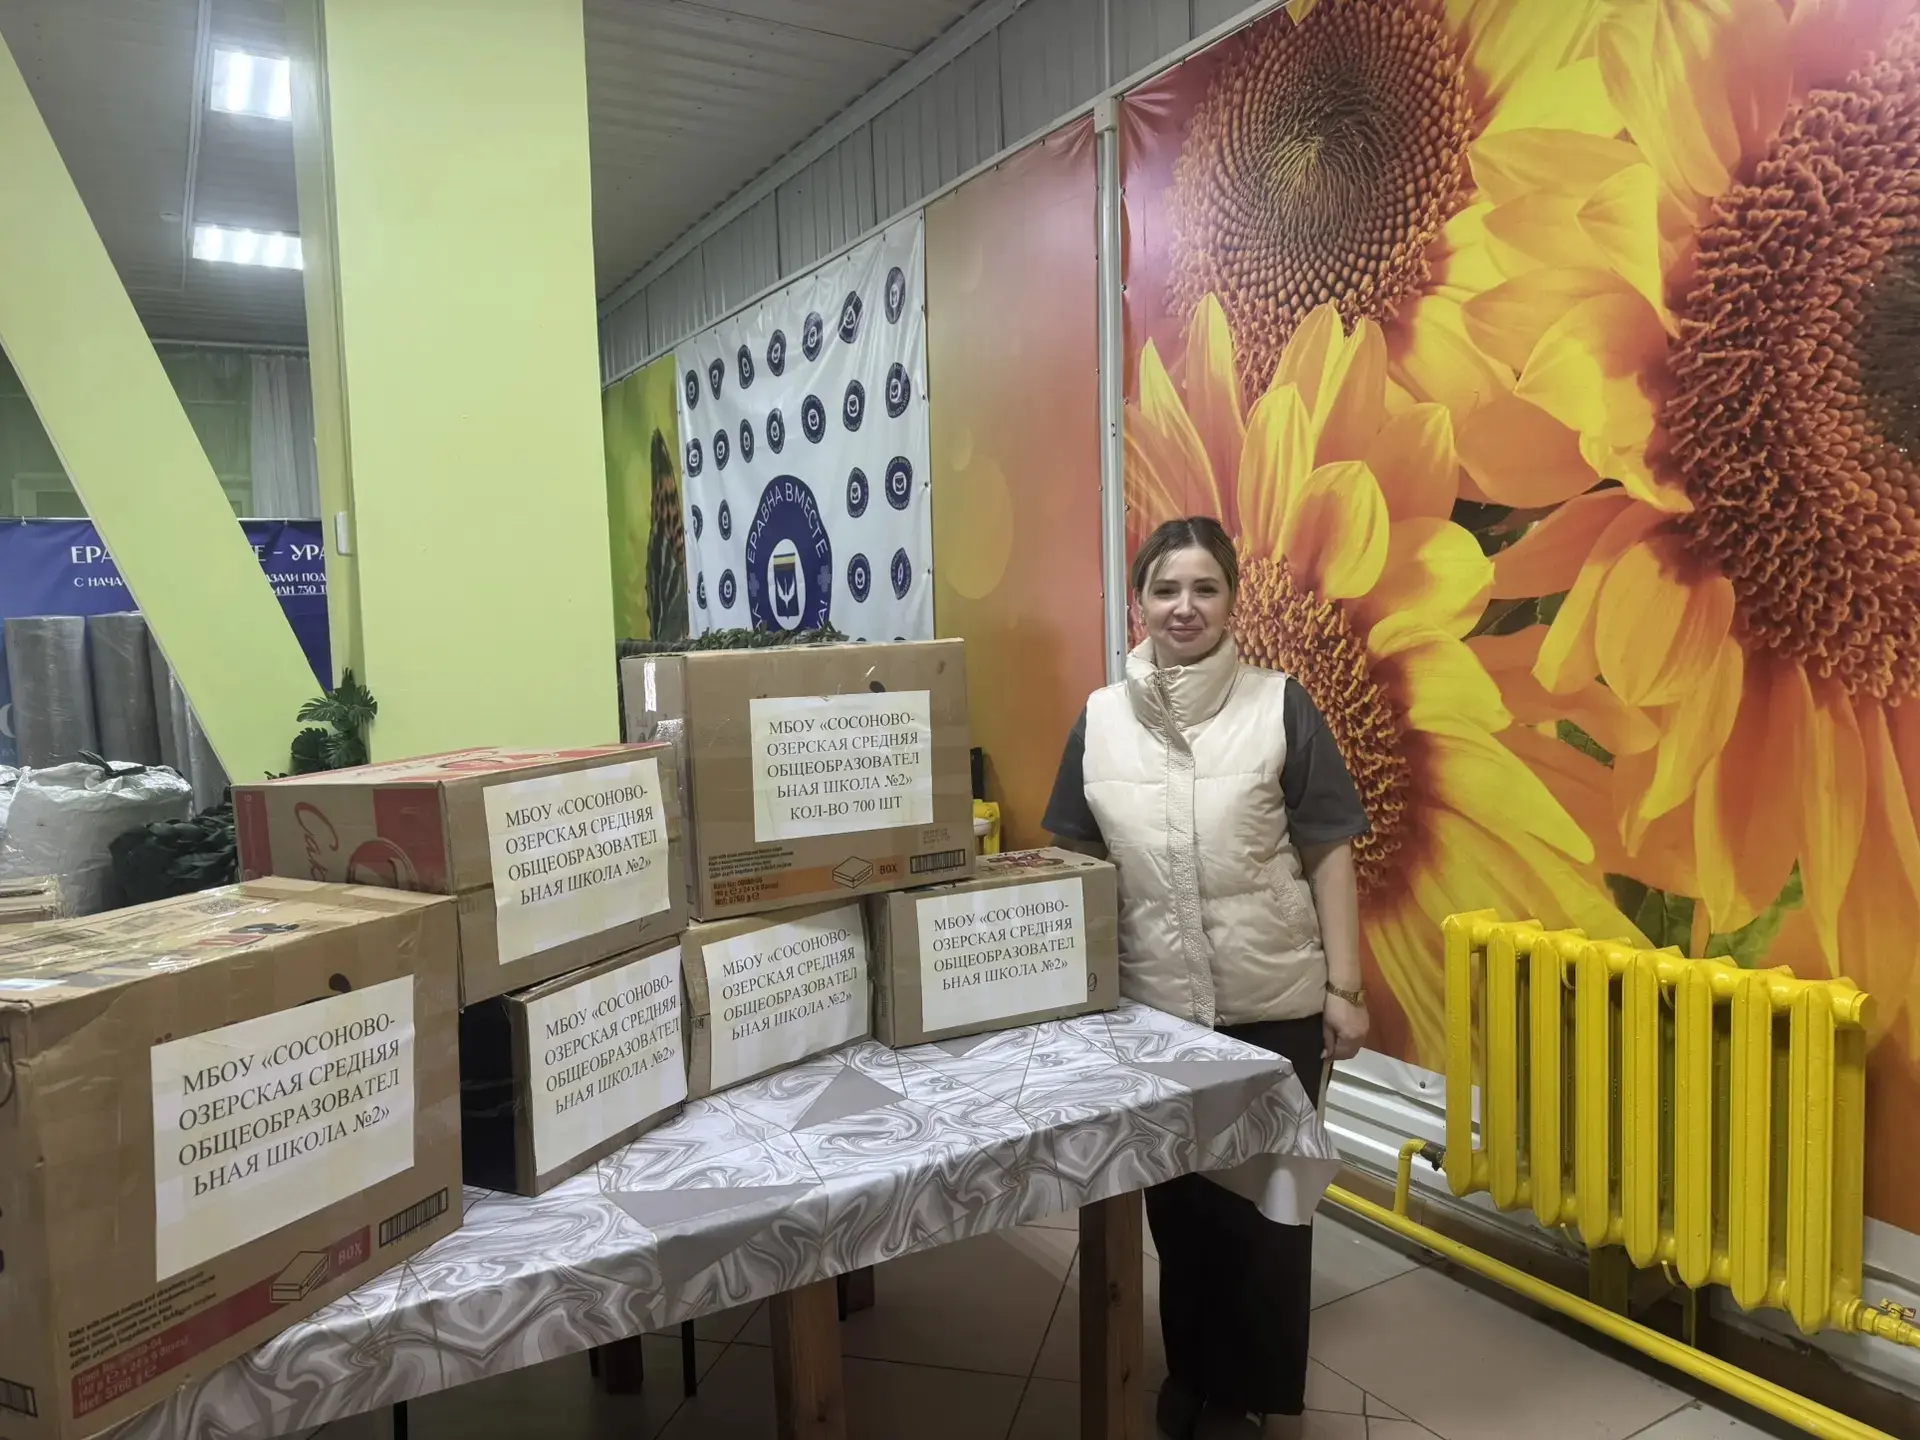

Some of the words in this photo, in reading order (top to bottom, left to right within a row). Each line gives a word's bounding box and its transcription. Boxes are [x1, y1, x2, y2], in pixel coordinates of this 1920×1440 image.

[748, 485, 783, 564] ЕРАВНА
[785, 482, 828, 558] ВМЕСТЕ
[74, 577, 84, 587] С
[88, 577, 124, 587] НАЧА
[298, 585, 316, 594] 730
[767, 738, 848, 757] ОЗЕРСКАЯ
[851, 732, 918, 750] СРЕДНЯЯ
[769, 718, 816, 735] МБОУ
[820, 712, 915, 731] «СОСОНОВО-
[767, 752, 920, 778] ОБЩЕОБРАЗОВАТЕЛ
[777, 782, 819, 798] ЬНАЯ
[824, 777, 881, 794] ШКОЛА
[884, 773, 913, 789] №2»
[505, 803, 552, 828] МБОУ
[557, 784, 648, 816] «СОСОНОВО-
[505, 822, 587, 855] ОЗЕРСКАЯ
[590, 806, 654, 834] СРЕДНЯЯ
[790, 801, 849, 820] КОЛ-ВО
[853, 799, 875, 813] 700
[879, 796, 903, 810] ШТ
[508, 829, 657, 882] ОБЩЕОБРАЗОВАТЕЛ
[879, 863, 898, 875] BOX
[520, 879, 563, 906] ЬНАЯ
[568, 864, 622, 892] ШКОЛА
[625, 856, 652, 875] №2»
[932, 929, 1006, 952] ОЗЕРСКАЯ
[1010, 917, 1072, 939] СРЕДНЯЯ
[934, 914, 975, 932] МБОУ
[979, 899, 1069, 924] «СОСОНОВО-
[722, 953, 763, 978] МБОУ
[767, 928, 851, 964] «СОСОНОВО-
[722, 966, 794, 1000] ОЗЕРСКАЯ
[797, 946, 855, 976] СРЕДНЯЯ
[934, 937, 1075, 972] ОБЩЕОБРАЗОВАТЕЛ
[942, 972, 981, 991] ЬНАЯ
[985, 963, 1037, 983] ШКОЛА
[1041, 958, 1068, 972] №2»
[545, 1008, 588, 1040] МБОУ
[591, 974, 673, 1020] «СОСОНОВО-
[723, 967, 857, 1022] ОБЩЕОБРАЗОВАТЕЛ
[732, 1016, 770, 1041] ЬНАЯ
[774, 999, 824, 1027] ШКОЛА
[827, 991, 852, 1009] №2»
[182, 1054, 254, 1096] МБОУ
[261, 1013, 396, 1070] «СОСОНОВО-
[545, 1021, 618, 1066] ОЗЕРСКАЯ
[621, 994, 677, 1032] СРЕДНЯЯ
[546, 1017, 680, 1092] ОБЩЕОБРАЗОВАТЕЛ
[178, 1072, 302, 1131] ОЗЕРСКАЯ
[309, 1039, 399, 1087] СРЕДНЯЯ
[556, 1083, 594, 1115] ЬНАЯ
[598, 1058, 648, 1094] ШКОЛА
[650, 1046, 675, 1068] №2»
[178, 1068, 399, 1167] ОБЩЕОБРАЗОВАТЕЛ
[193, 1152, 259, 1197] ЬНАЯ
[267, 1120, 348, 1167] ШКОЛА
[353, 1106, 390, 1133] №2»
[338, 1242, 362, 1265] BOX
